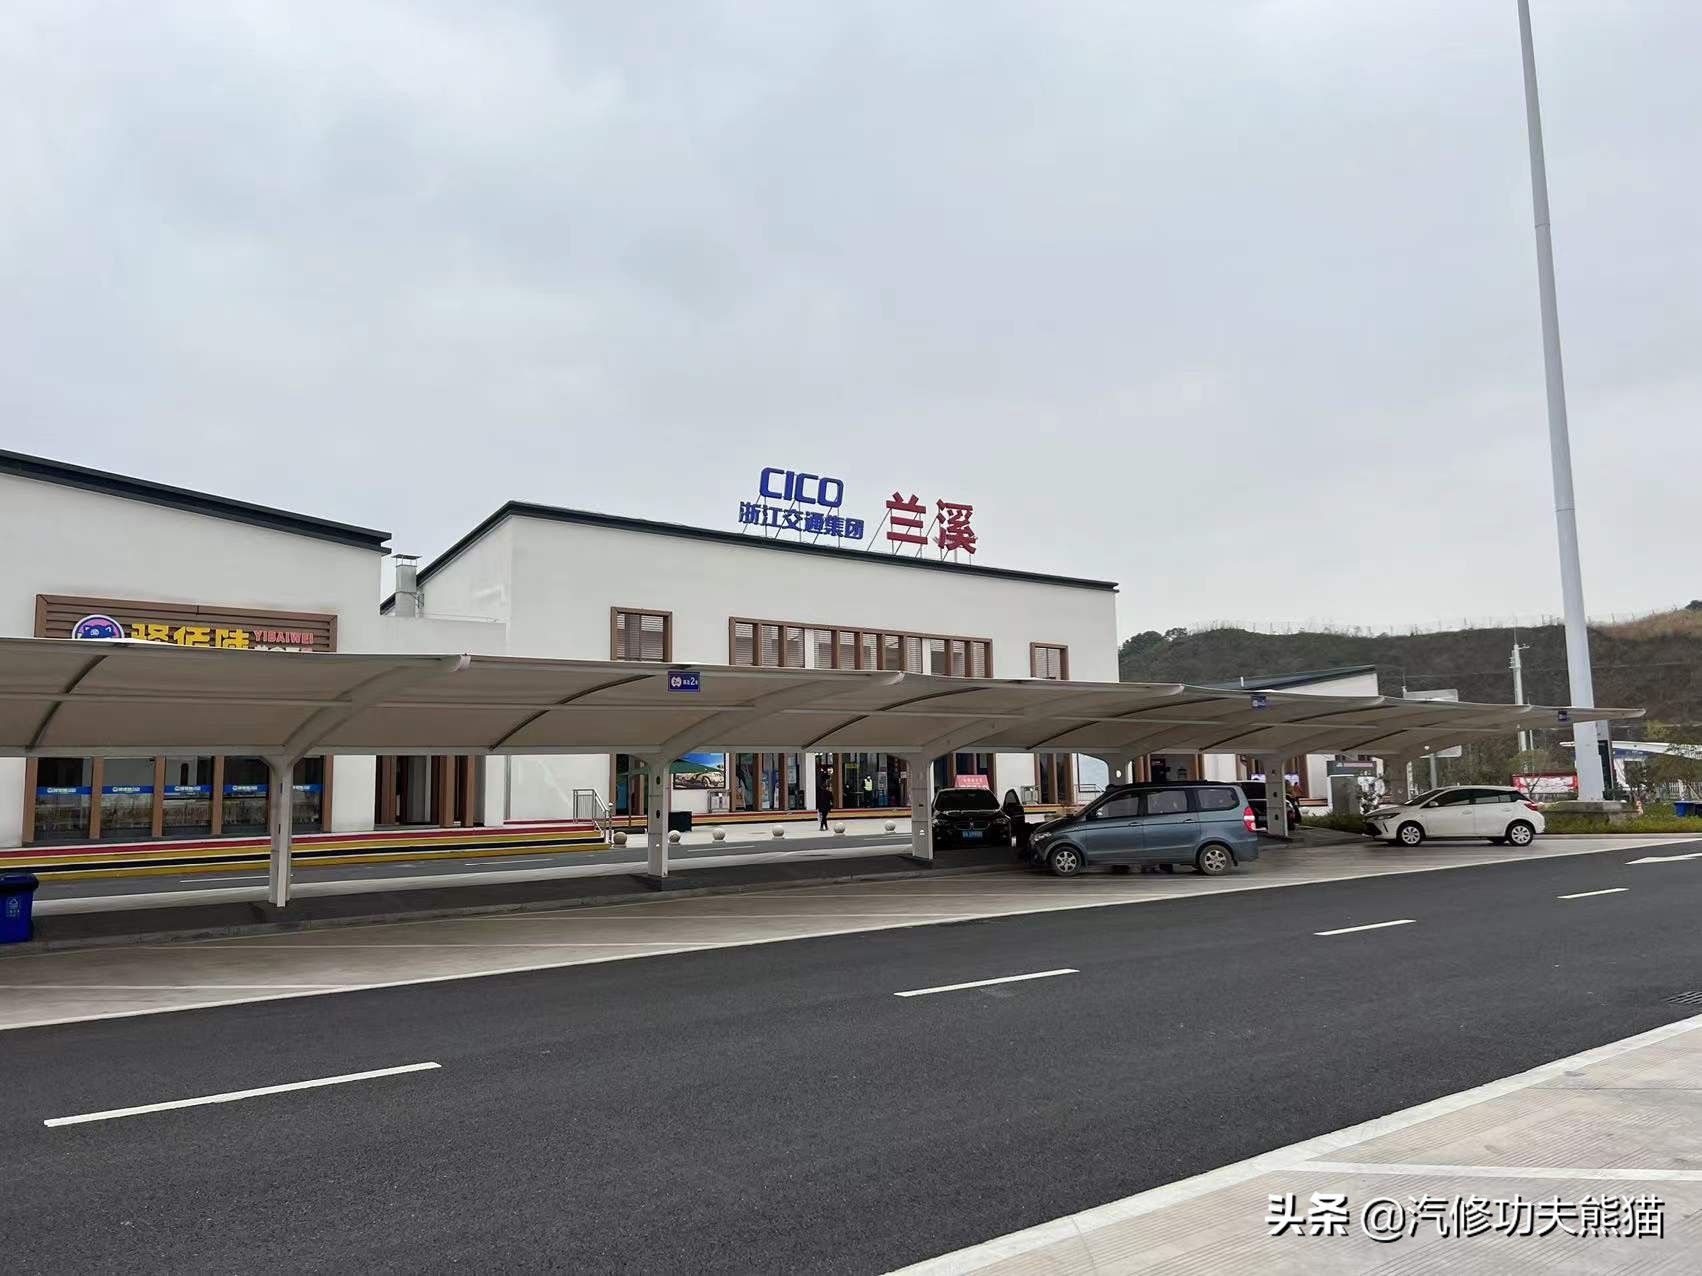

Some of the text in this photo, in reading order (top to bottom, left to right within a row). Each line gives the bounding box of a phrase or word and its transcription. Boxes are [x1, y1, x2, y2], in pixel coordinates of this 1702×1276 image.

[759, 467, 844, 508] CICO
[738, 501, 865, 540] 浙江交通集团
[886, 491, 977, 555] 兰溪
